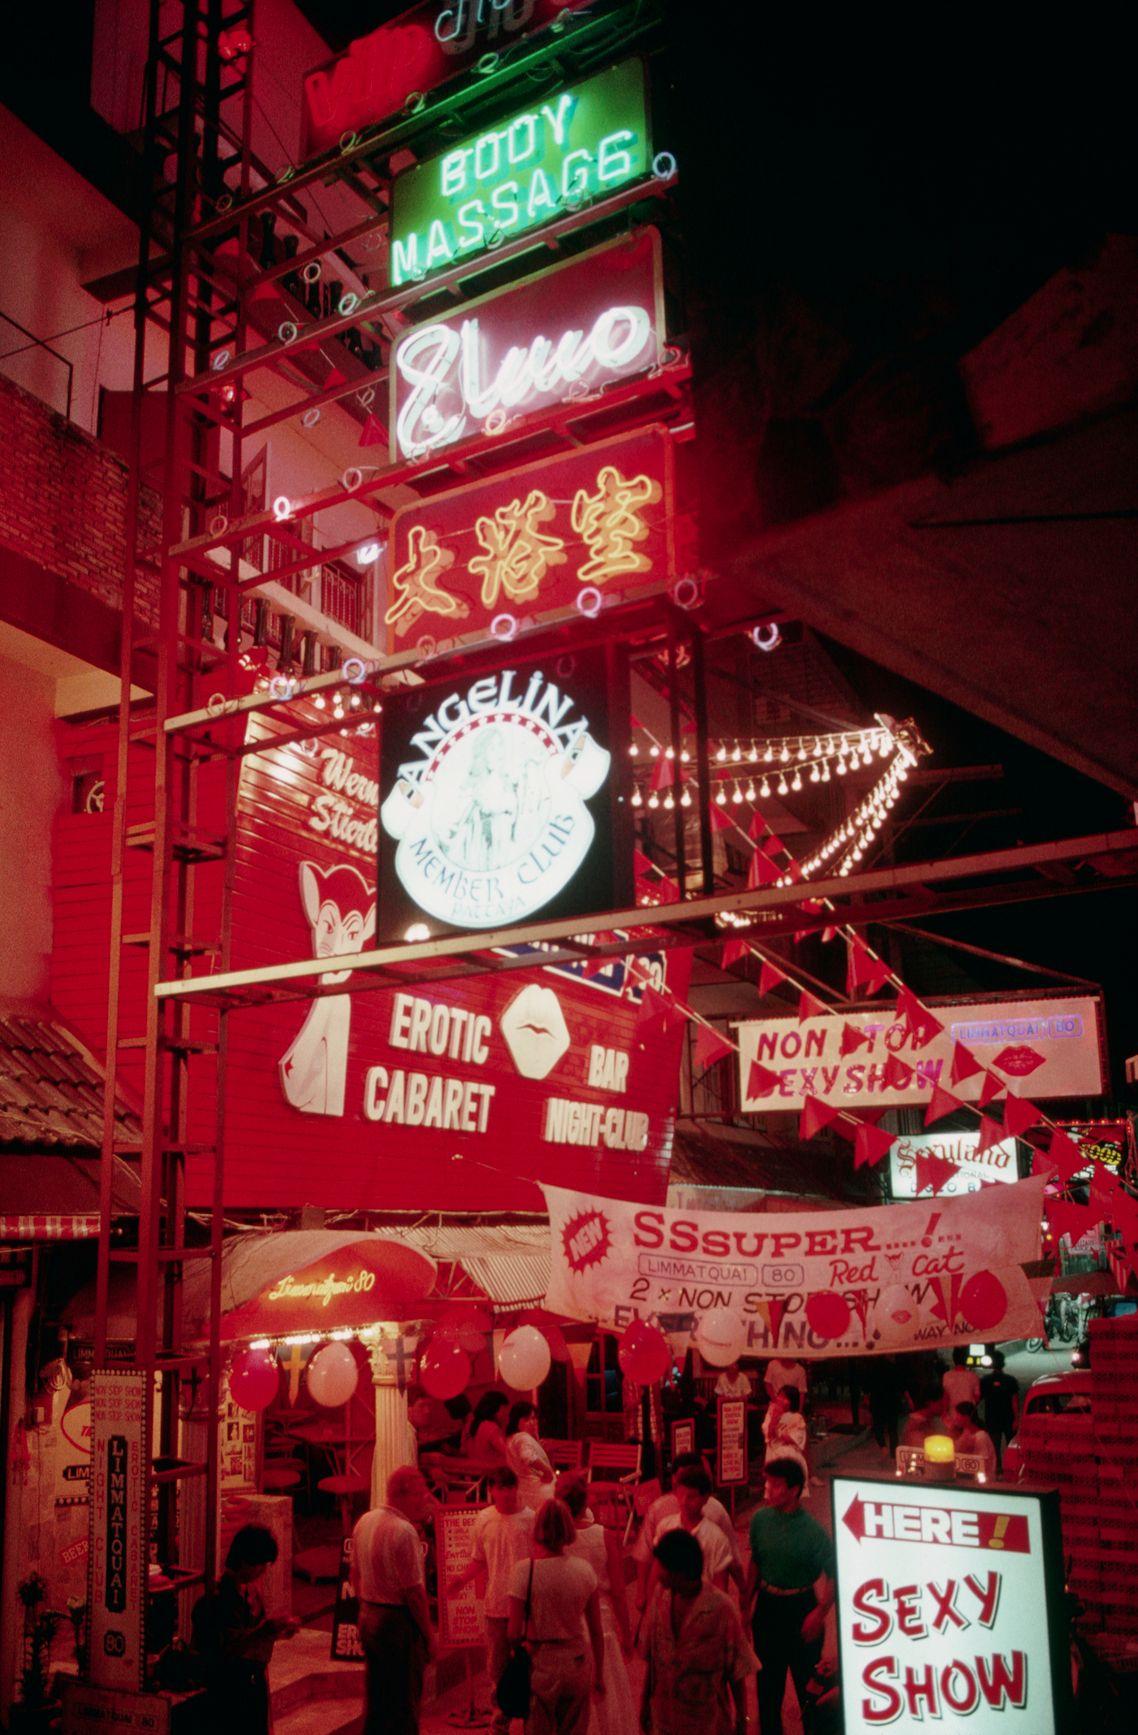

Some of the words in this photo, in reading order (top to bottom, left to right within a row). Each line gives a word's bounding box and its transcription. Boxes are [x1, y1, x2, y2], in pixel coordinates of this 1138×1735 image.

[440, 94, 574, 196] BODY
[392, 130, 636, 285] MASSAGE
[409, 838, 505, 902] MEMBER
[517, 815, 576, 885] CLUB
[389, 993, 492, 1065] EROTIC
[757, 1028, 827, 1060] NON
[588, 1045, 630, 1094] BAR
[363, 1066, 497, 1134] CABARET
[568, 1217, 604, 1264] NEW
[829, 1256, 879, 1287] Red
[912, 1246, 964, 1276] Cat
[354, 1270, 375, 1293] 80
[630, 1278, 650, 1301] 2
[678, 1288, 732, 1309] NON
[648, 1260, 748, 1282] LIMMATQUAI
[772, 1270, 796, 1282] 80
[96, 1438, 105, 1520] NIGHT
[110, 1439, 125, 1605] LIMMATQUAI
[862, 1503, 982, 1547] HERE
[852, 1570, 1002, 1647] SEXY
[106, 1633, 124, 1653] 80
[861, 1649, 1028, 1726] SHOW
